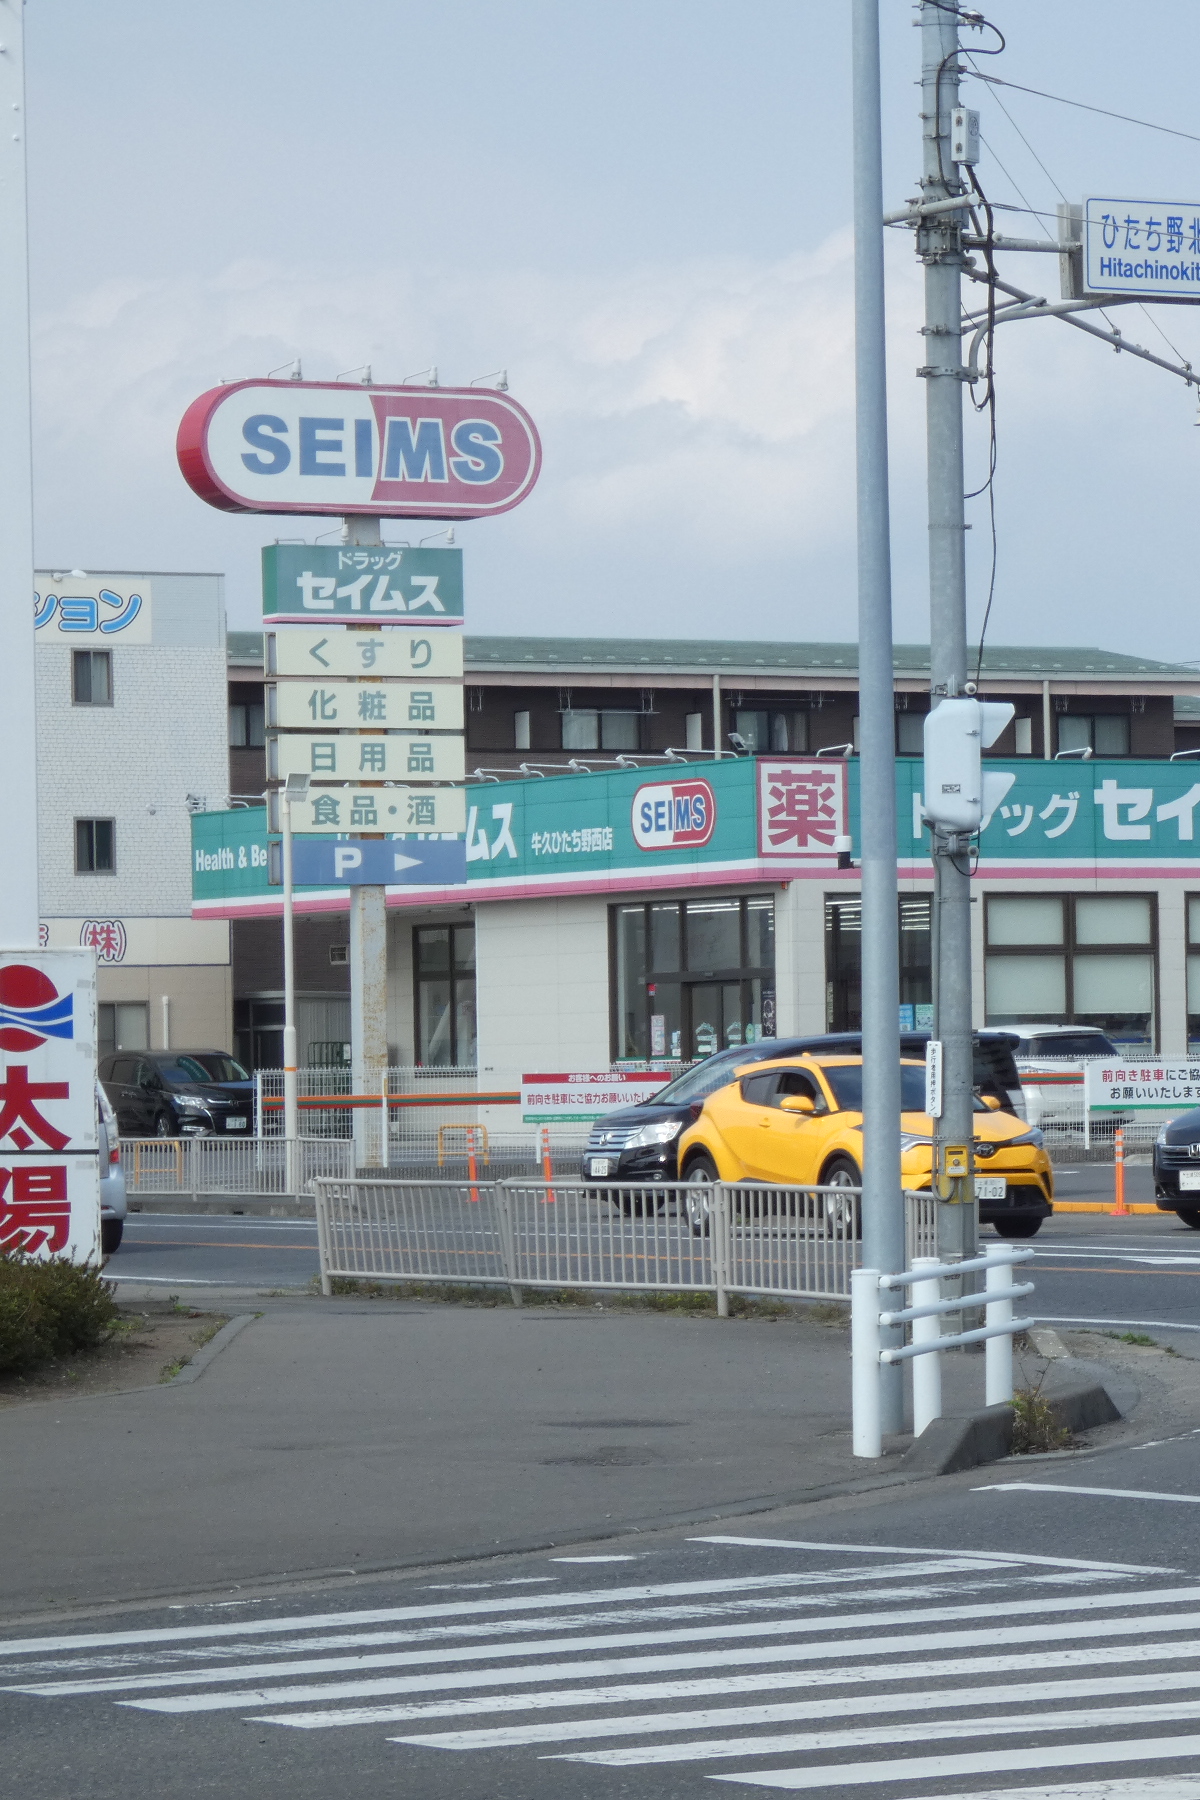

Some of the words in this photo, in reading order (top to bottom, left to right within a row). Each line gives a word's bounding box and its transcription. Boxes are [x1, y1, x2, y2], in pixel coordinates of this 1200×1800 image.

[240, 412, 506, 485] SEIMS
[337, 550, 403, 571] ドラッグ
[296, 571, 445, 613] セイムス
[309, 639, 434, 670] くすり
[308, 690, 436, 722] 化粧品
[310, 742, 436, 773] 日用品
[310, 795, 436, 827] 食品・酒
[640, 795, 707, 834] SEIMS
[767, 769, 838, 848] 薬
[531, 827, 613, 856] 牛久ひたち野西店
[195, 847, 234, 872] Health
[238, 846, 248, 868] &
[334, 847, 362, 878] P
[568, 1073, 627, 1083] お客様へのお願い
[976, 1186, 1004, 1197] 71-02
